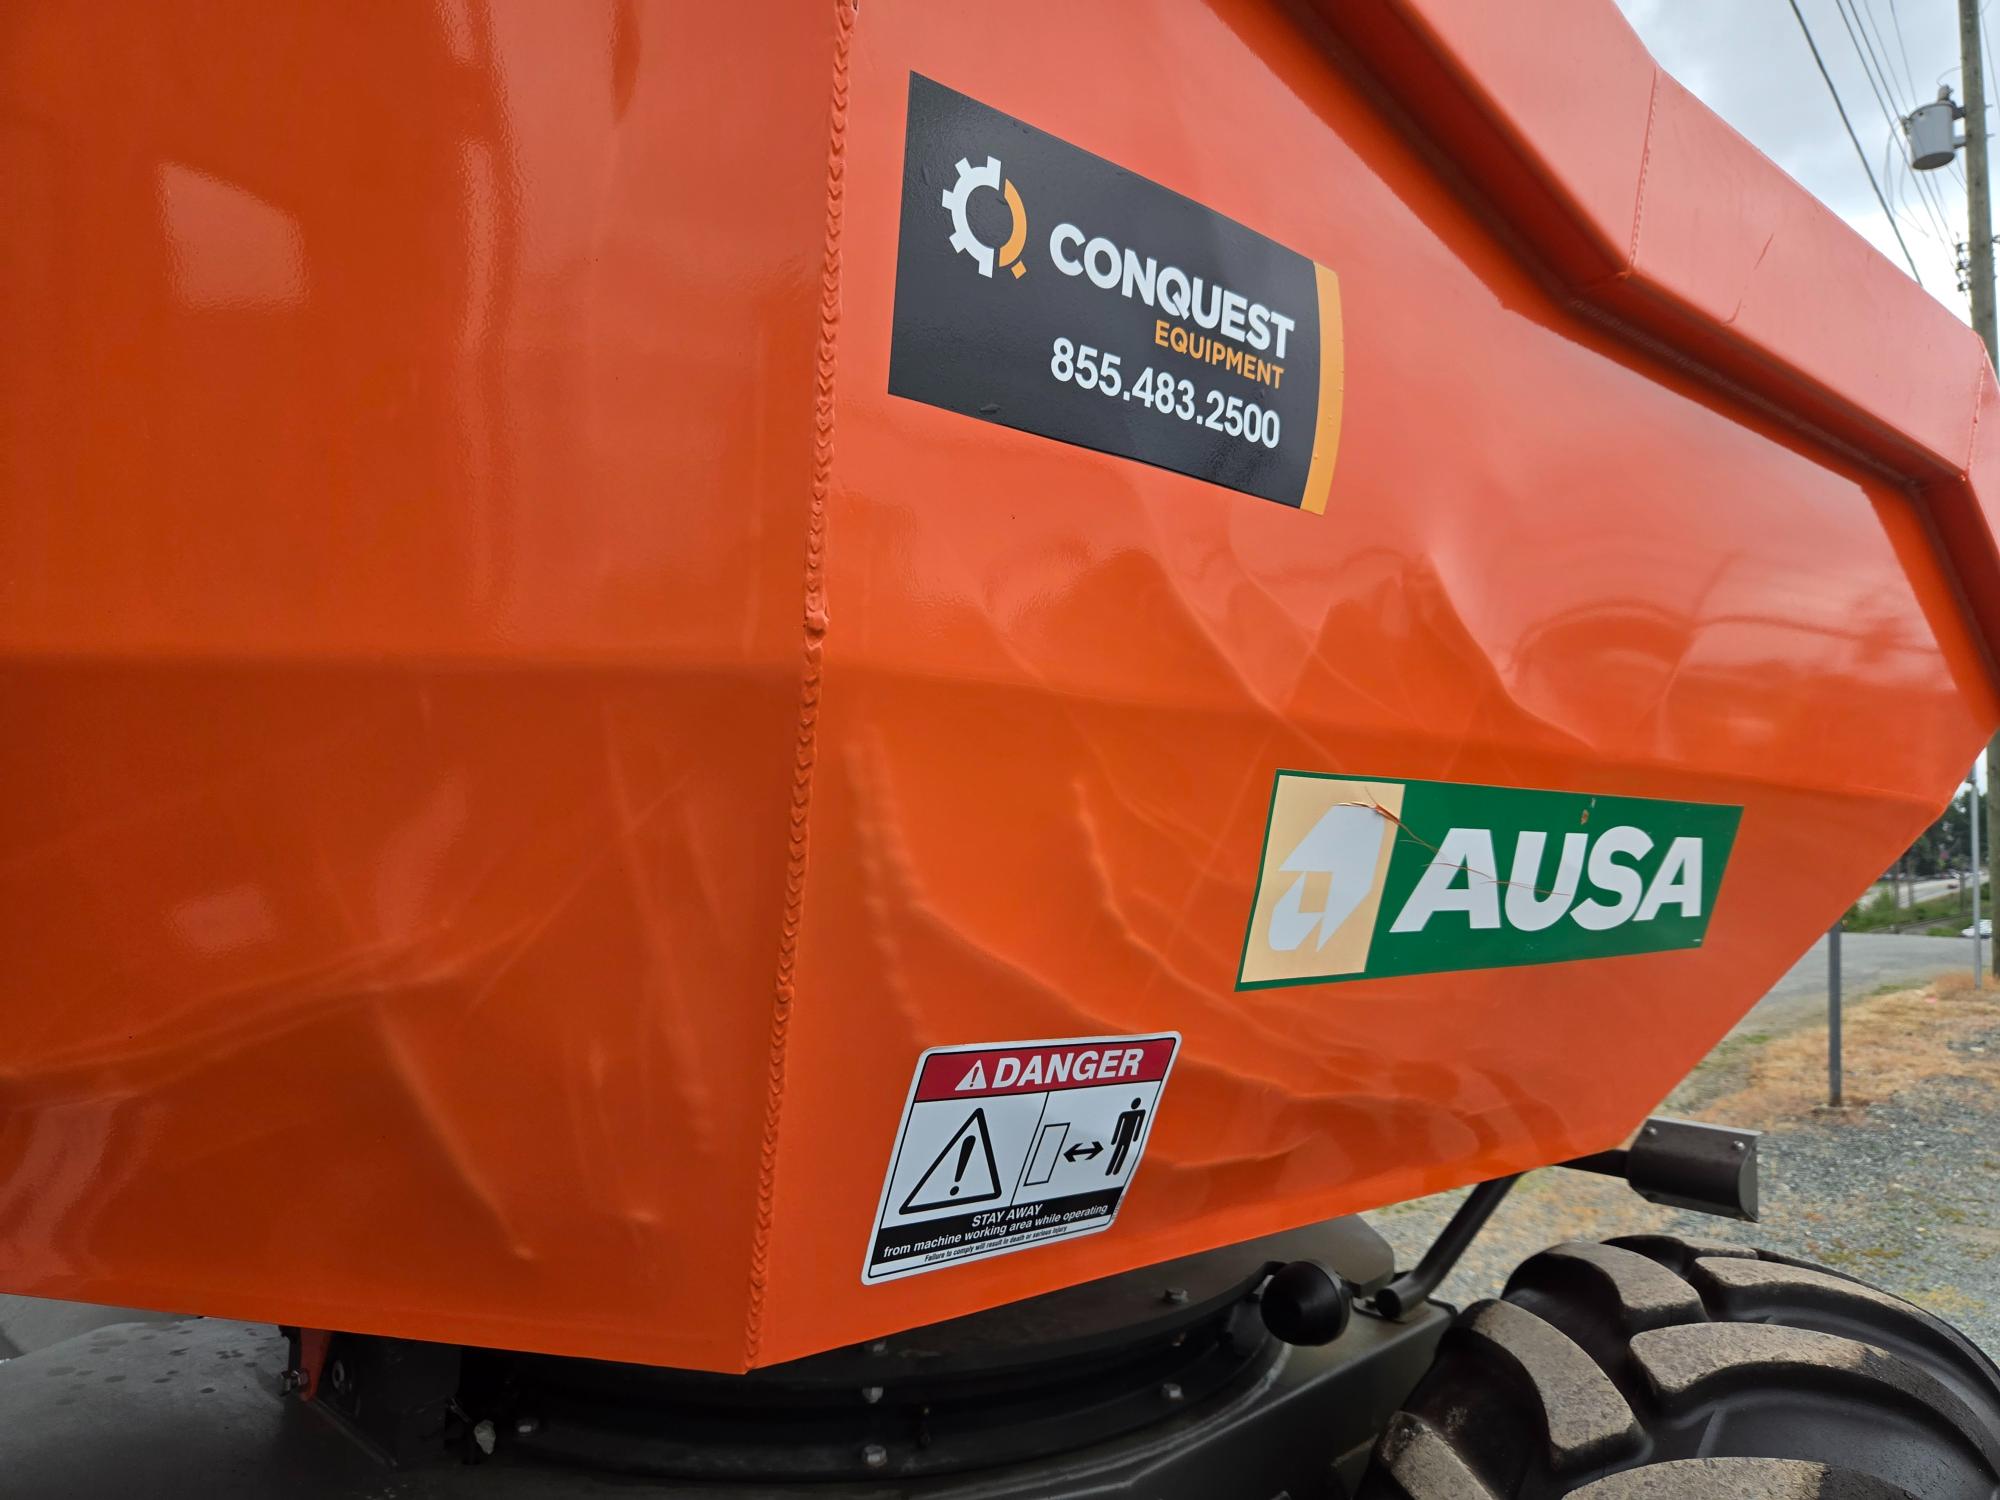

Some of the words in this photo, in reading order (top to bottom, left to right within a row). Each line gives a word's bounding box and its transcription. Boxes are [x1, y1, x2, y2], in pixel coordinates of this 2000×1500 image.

[1050, 223, 1294, 358] CONQUEST
[1155, 320, 1284, 389] EQUIPMENT
[1051, 337, 1280, 448] 855.483.2500
[1389, 825, 1703, 932] AUSA
[991, 1048, 1144, 1088] DANGER
[883, 1246, 911, 1258] from
[913, 1234, 961, 1252] machine
[964, 1225, 1007, 1240] working
[1009, 1221, 1032, 1232] area
[1034, 1214, 1061, 1226] while
[1062, 1204, 1108, 1222] operating
[924, 1252, 945, 1262] Failure
[946, 1249, 952, 1257] to
[953, 1245, 974, 1255] comply
[974, 1242, 985, 1251] will
[986, 1240, 1002, 1249] result
[1009, 1235, 1025, 1243] death
[1032, 1229, 1052, 1238] serious
[972, 1211, 1005, 1227] STAY
[1006, 1204, 1043, 1220] AWAY
